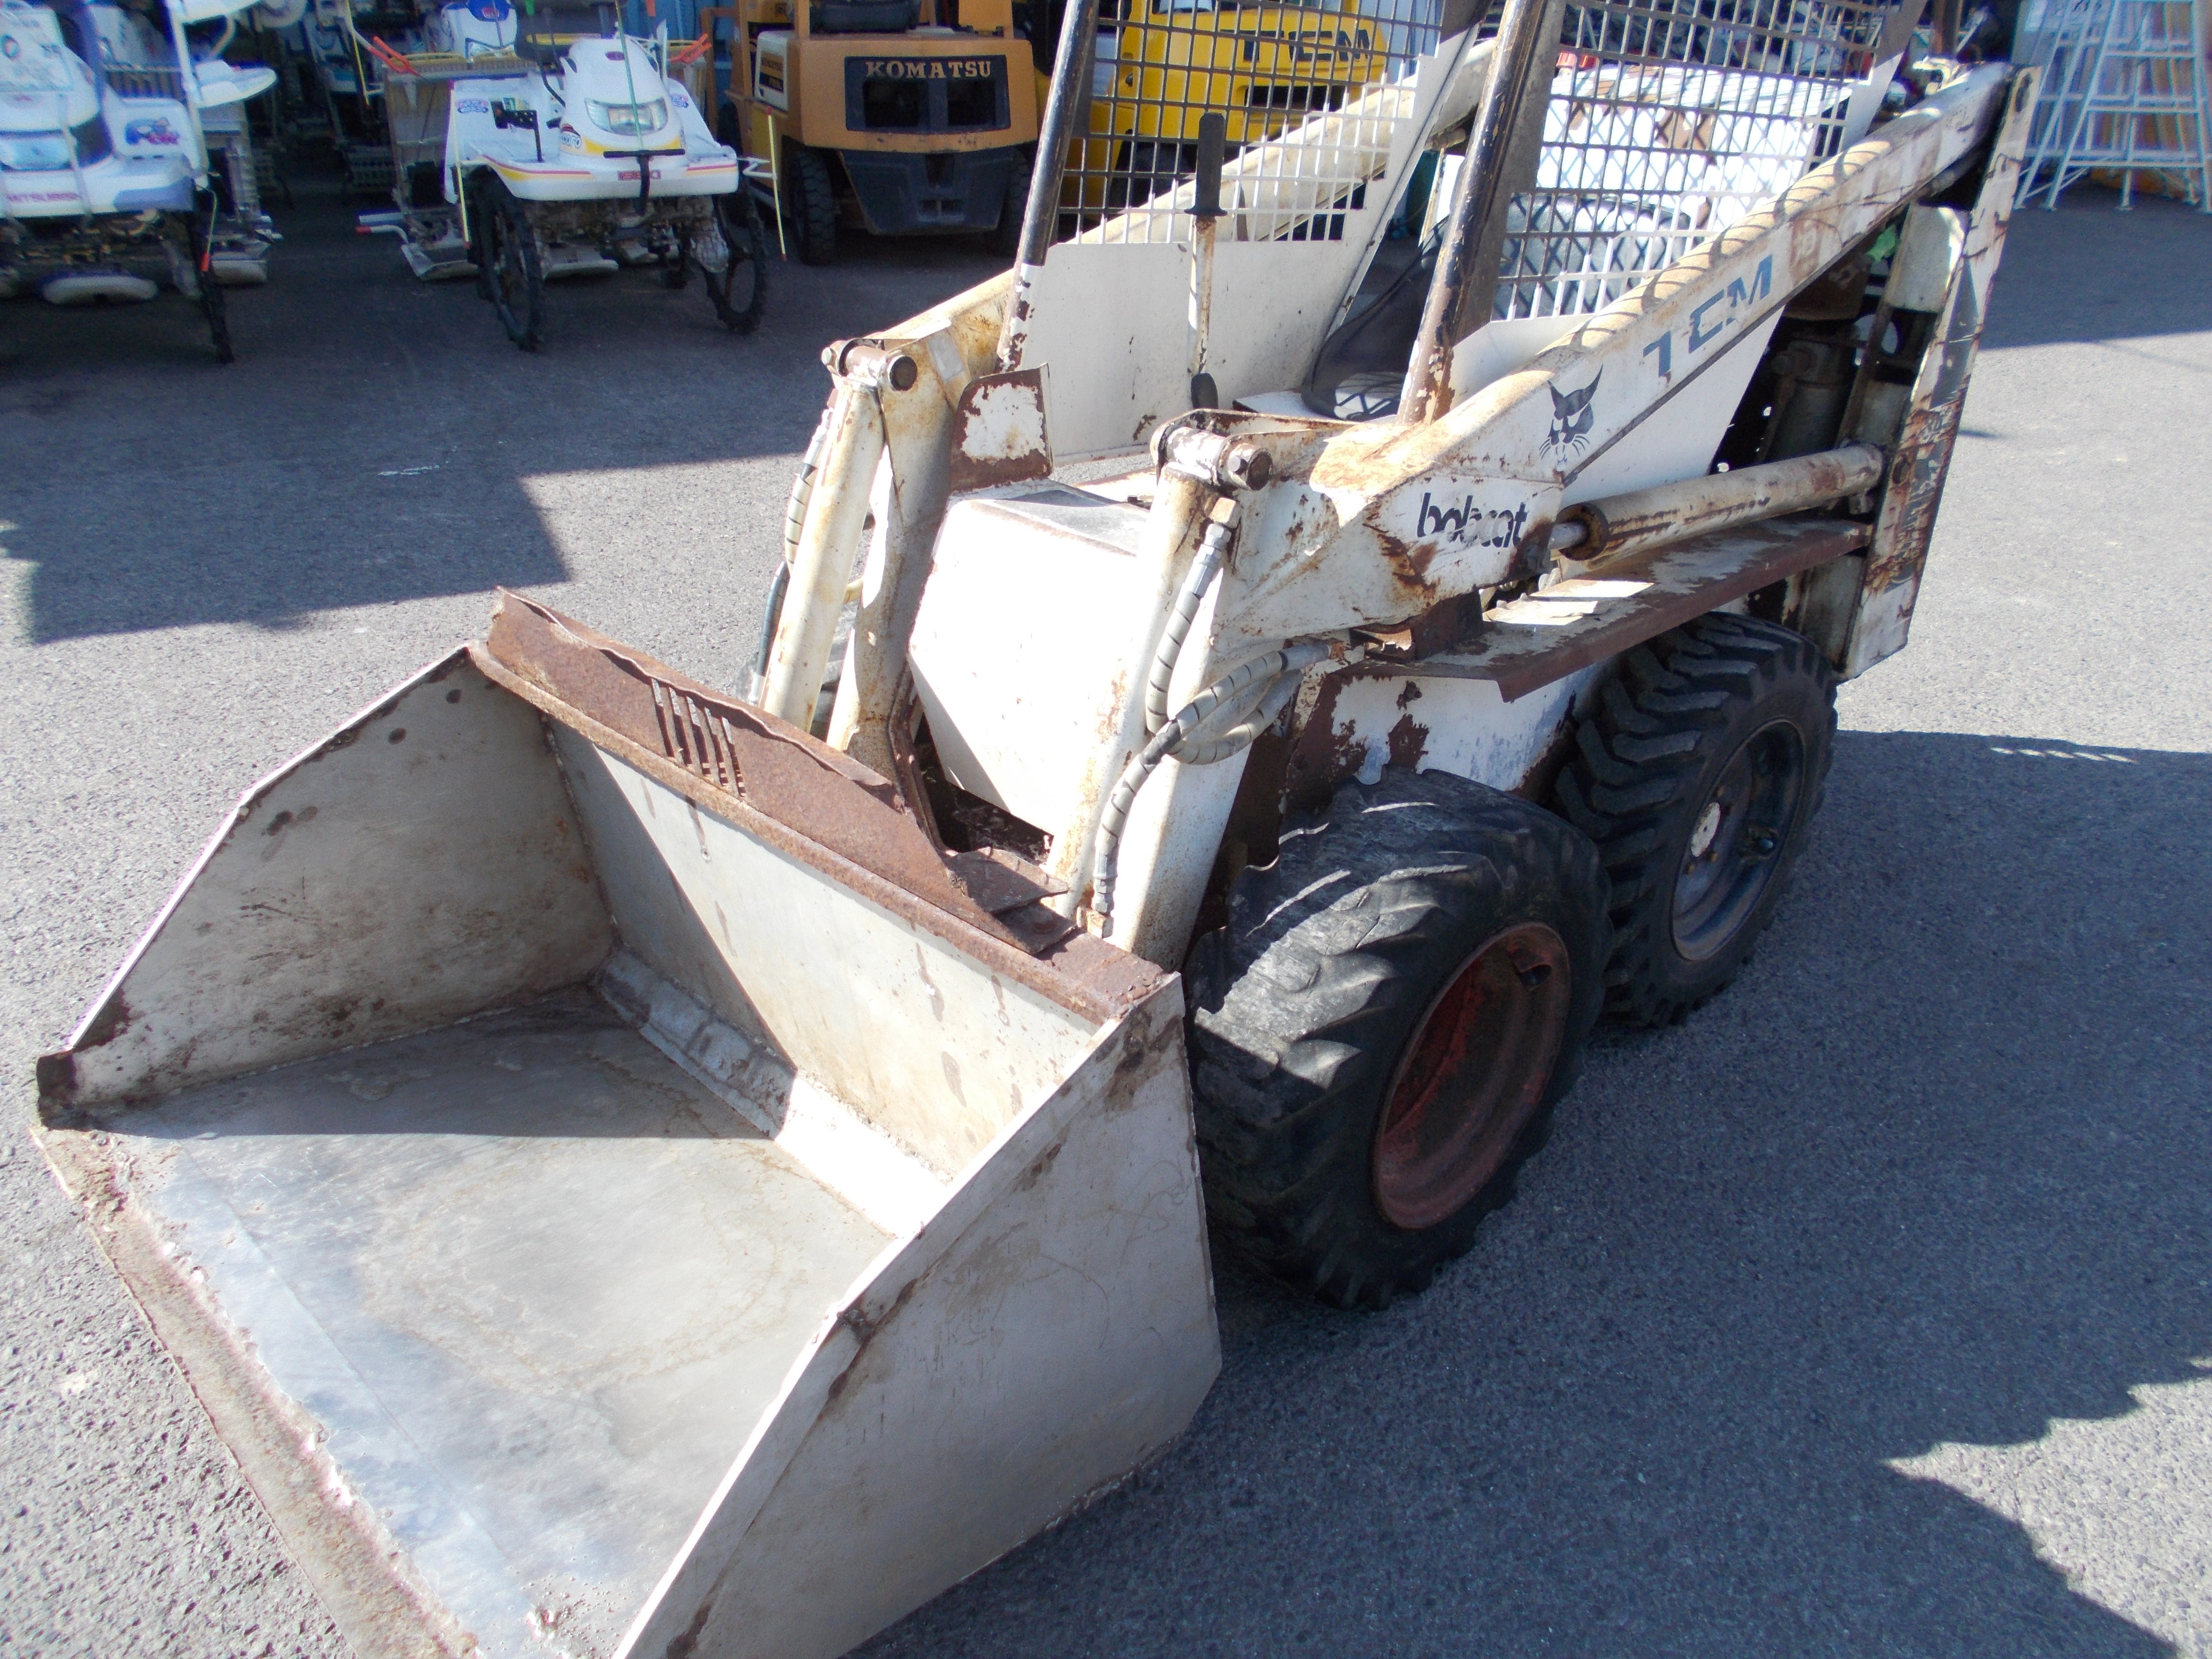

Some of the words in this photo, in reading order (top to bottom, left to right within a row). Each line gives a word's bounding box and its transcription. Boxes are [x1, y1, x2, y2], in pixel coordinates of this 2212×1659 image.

[1220, 29, 1371, 62] TCM
[865, 60, 991, 79] KOMATSU
[1643, 254, 1773, 378] TCM
[1417, 492, 1527, 548] bobcat
